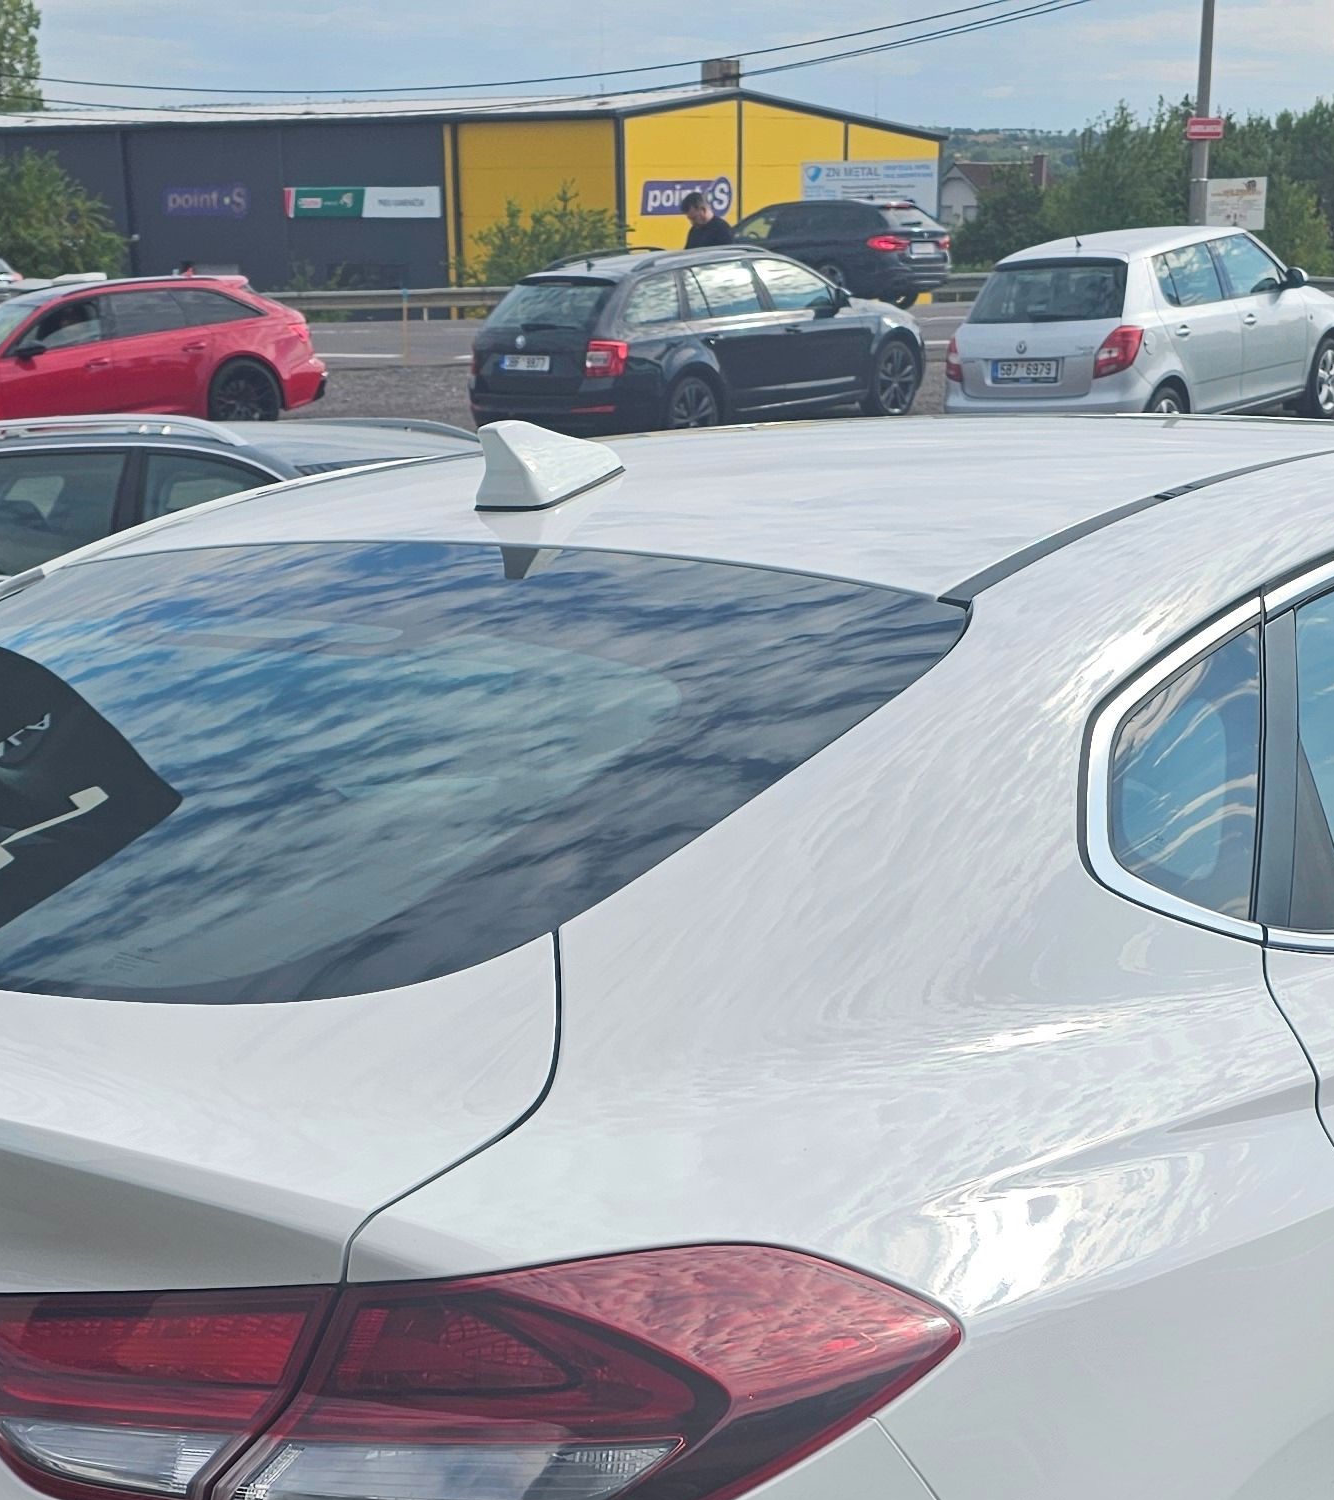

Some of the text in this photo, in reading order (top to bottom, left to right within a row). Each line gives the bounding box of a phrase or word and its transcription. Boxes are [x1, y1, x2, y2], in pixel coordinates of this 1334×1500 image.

[844, 167, 881, 178] METAL
[168, 188, 218, 210] point
[1026, 363, 1052, 376] 6979
